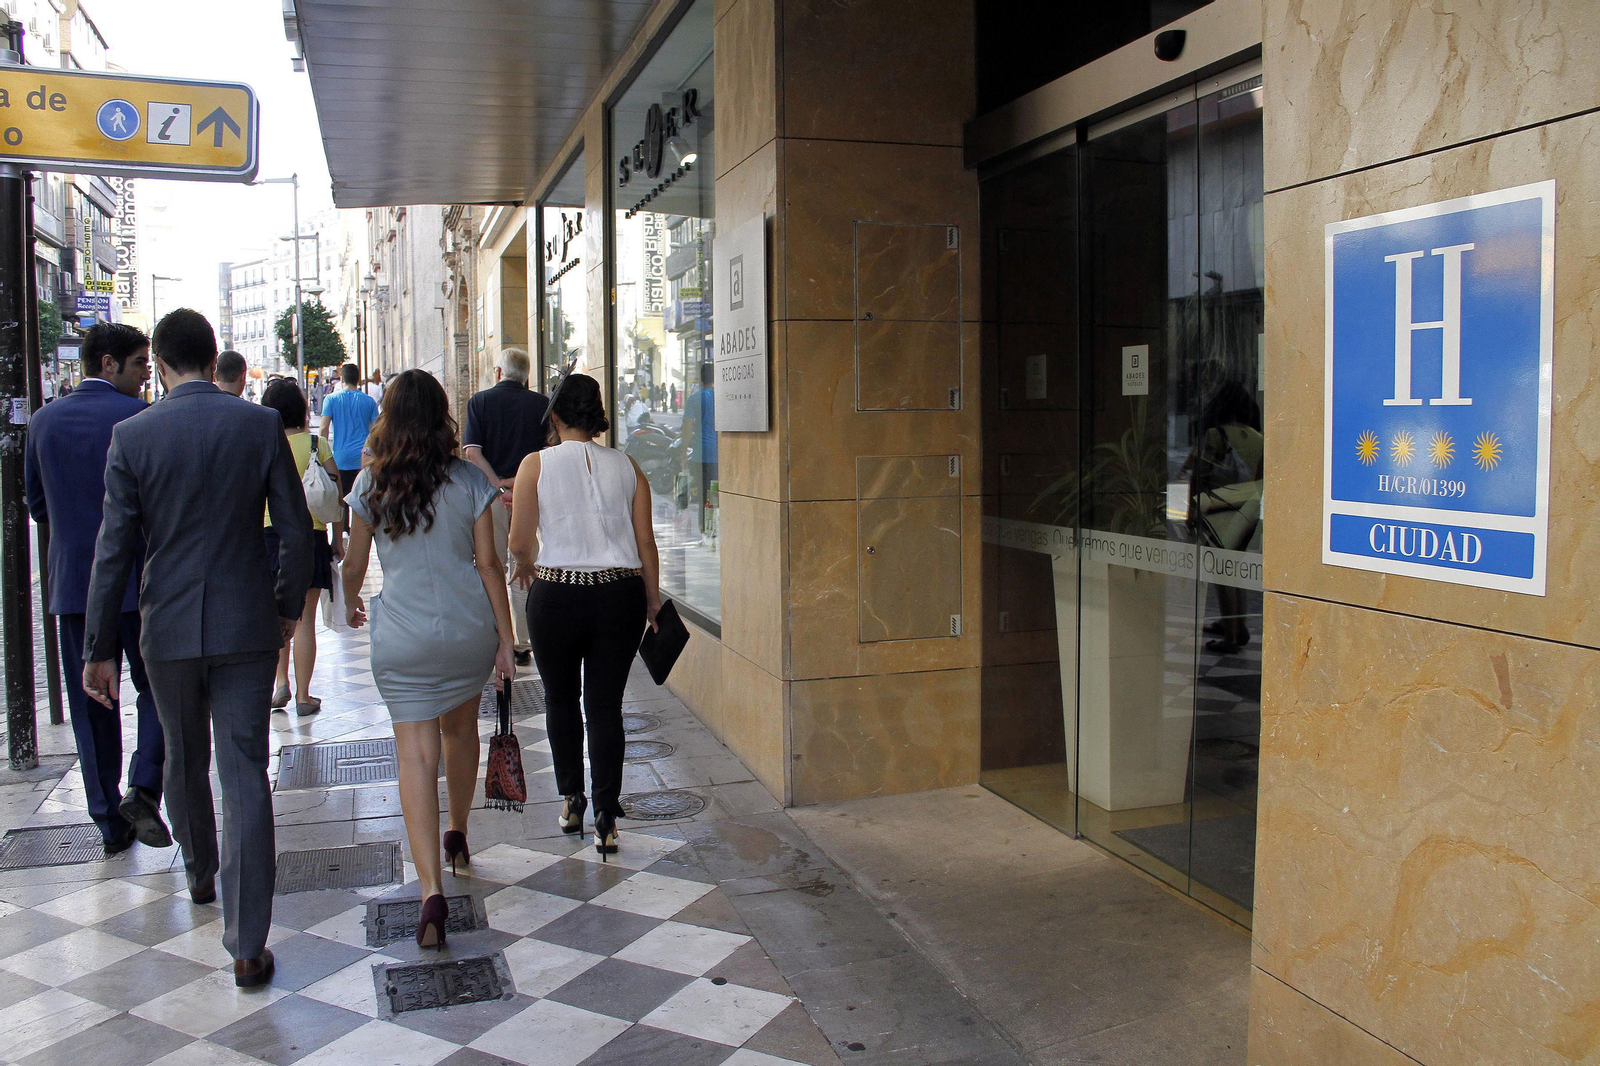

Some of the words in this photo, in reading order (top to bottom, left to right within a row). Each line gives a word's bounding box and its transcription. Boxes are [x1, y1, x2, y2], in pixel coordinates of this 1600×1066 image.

[26, 84, 67, 112] de
[4, 127, 23, 146] o
[1382, 242, 1475, 407] H
[720, 325, 757, 356] ABADES
[722, 363, 755, 382] RECOGIDAS
[1126, 372, 1145, 380] ABADES
[1378, 474, 1466, 499] H/GR/01399
[1014, 526, 1049, 549] vengas
[1119, 541, 1143, 564] que
[1146, 545, 1195, 572] vengas
[1369, 521, 1483, 565] CIUDAD
